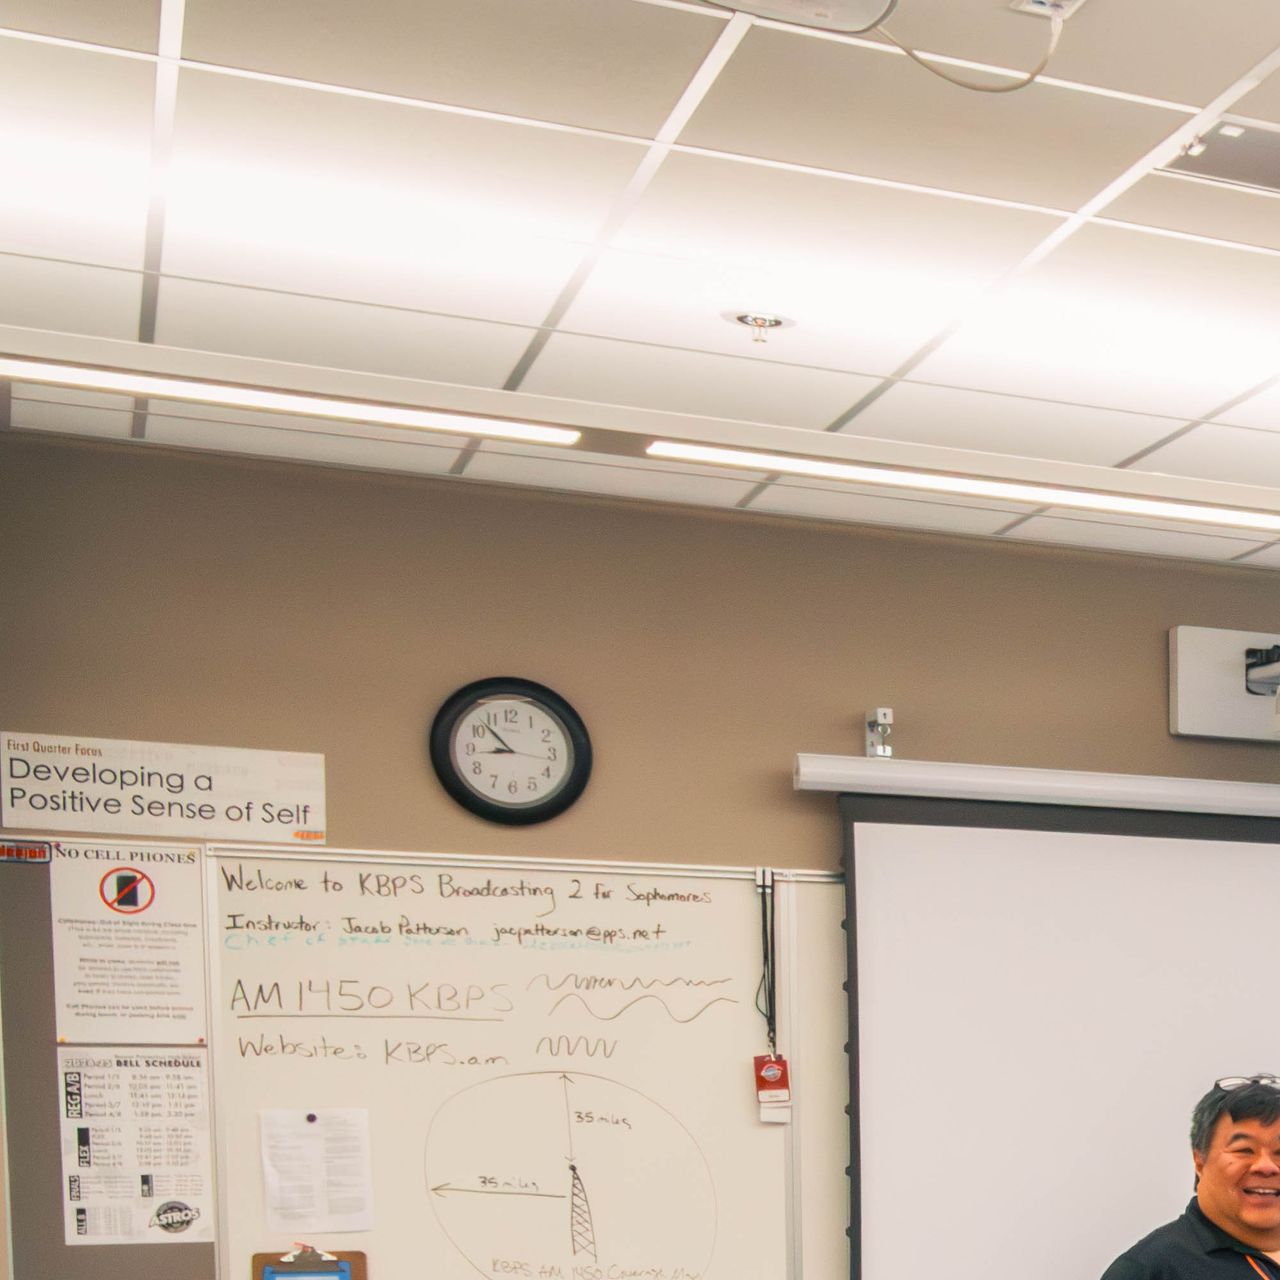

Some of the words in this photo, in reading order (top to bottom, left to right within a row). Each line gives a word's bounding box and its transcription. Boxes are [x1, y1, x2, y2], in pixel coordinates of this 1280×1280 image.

[487, 713, 498, 727] 11
[504, 709, 518, 723] 12
[528, 716, 533, 728] 1
[472, 724, 486, 738] 10
[541, 729, 552, 743] 2
[7, 739, 29, 752] First
[32, 741, 72, 755] Quarter
[548, 748, 557, 762] 3
[473, 761, 482, 775] 8
[541, 766, 551, 779] 4
[9, 757, 185, 794] Developing
[193, 772, 214, 792] a
[490, 774, 498, 788] 7
[508, 780, 518, 794] 6
[527, 777, 538, 791] 5
[10, 788, 122, 814] Positive
[131, 795, 216, 820] Sense
[225, 801, 253, 822] of
[262, 803, 311, 825] Self
[56, 848, 79, 859] NO
[84, 848, 126, 861] CELL
[129, 852, 197, 864] PHONES
[221, 864, 308, 892] Welcome
[321, 871, 343, 892] to
[359, 873, 424, 897] KBPS
[438, 873, 556, 917] Broadcasting
[568, 879, 582, 900] 2
[626, 882, 712, 906] Sophomores
[341, 917, 391, 935] Jacob
[398, 915, 468, 936] Patterson
[231, 979, 283, 1011] AM
[298, 979, 394, 1011] 1450
[407, 982, 514, 1013] KBPS
[238, 1033, 368, 1060] Website:
[115, 1059, 140, 1068] BELL
[145, 1059, 201, 1068] SCHEDULE
[575, 1111, 595, 1123] 35
[478, 1174, 498, 1188] 35
[149, 1207, 201, 1228] ASTROS
